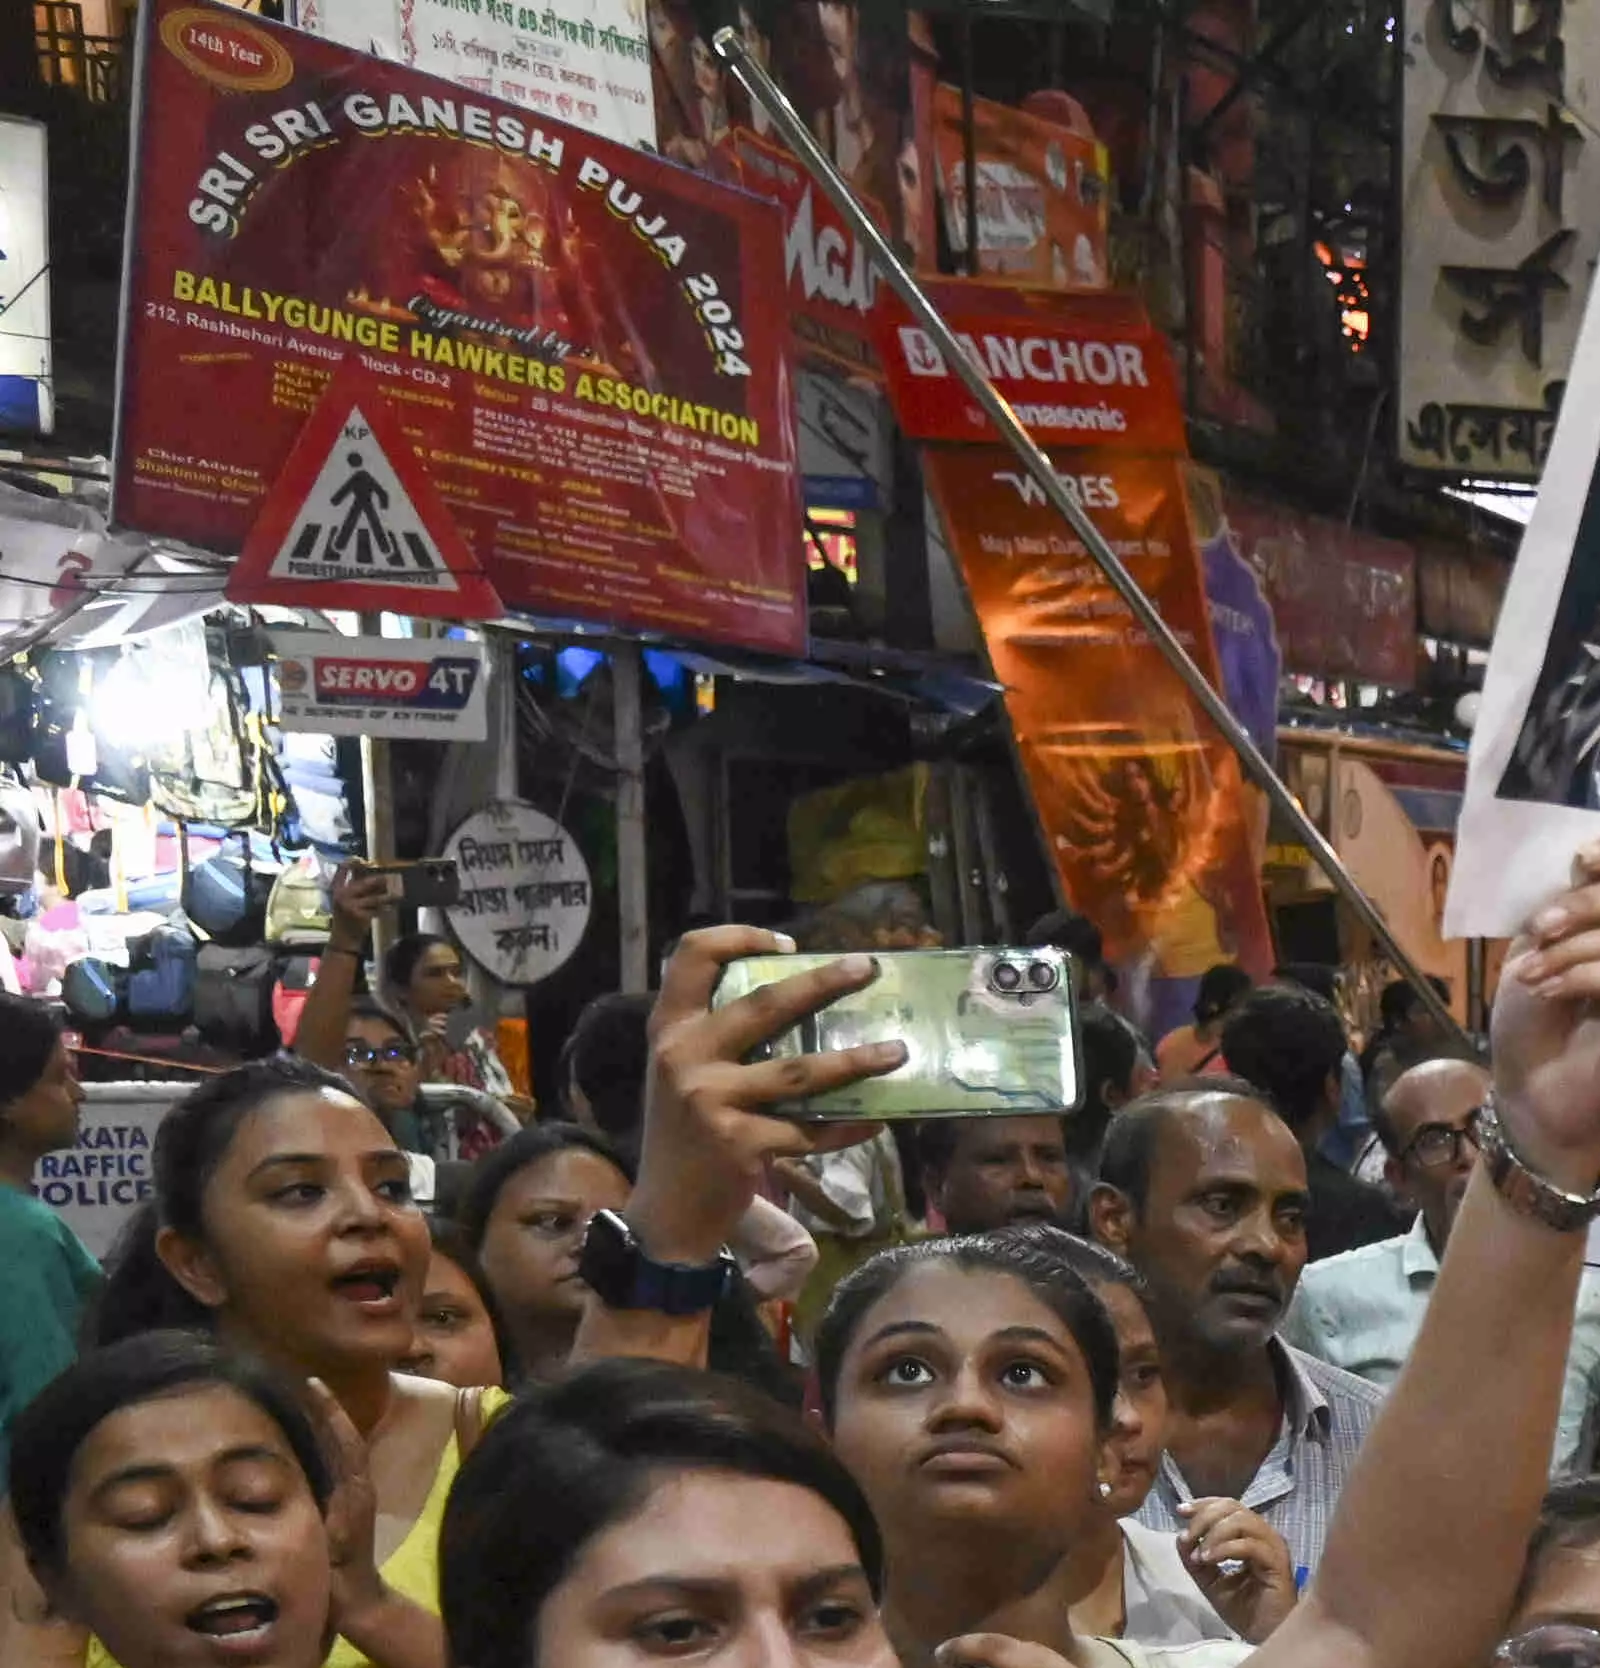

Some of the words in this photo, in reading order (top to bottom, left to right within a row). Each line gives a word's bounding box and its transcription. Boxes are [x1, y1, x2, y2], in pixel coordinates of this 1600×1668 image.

[188, 28, 223, 53] 14th
[227, 42, 265, 67] Year
[188, 151, 255, 233] SRI
[245, 101, 333, 160] SRI
[343, 94, 566, 168] GANESH
[578, 156, 688, 267] PUJA
[685, 272, 753, 378] 2024
[173, 270, 399, 353] BALLYGUNGE
[411, 325, 566, 394] HAWKERS
[575, 375, 760, 447] ASSOCIATION
[953, 331, 1149, 387] ANCHOR
[1012, 401, 1127, 432] anasonic
[993, 472, 1120, 508] WRES
[321, 664, 417, 692] SERVO
[428, 665, 471, 695] 4T
[74, 1126, 149, 1150] KATA
[41, 1153, 146, 1179] RAFFIC
